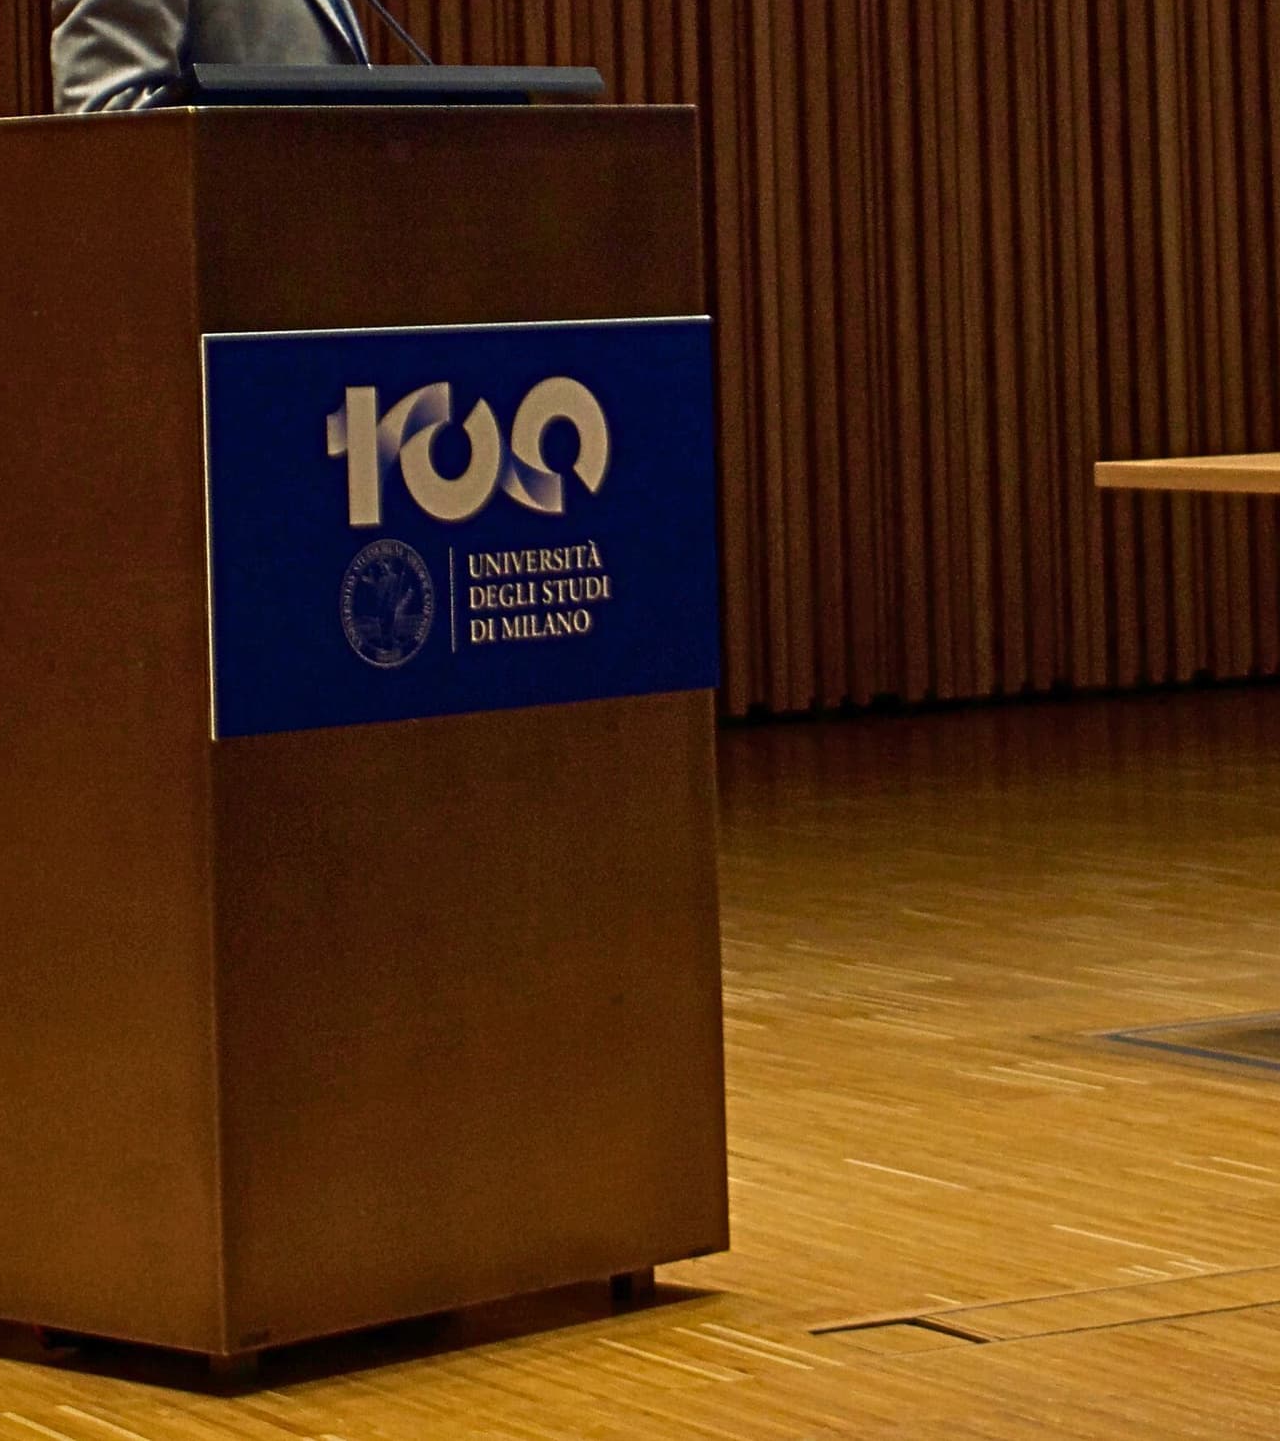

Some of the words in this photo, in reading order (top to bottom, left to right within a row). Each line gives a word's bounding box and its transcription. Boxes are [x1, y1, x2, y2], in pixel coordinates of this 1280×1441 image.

[468, 539, 603, 578] UNIVERSITÀ
[469, 581, 537, 609] DEGLI
[541, 575, 611, 605] STUDI
[470, 618, 495, 643] DI
[501, 608, 592, 640] MILANO
